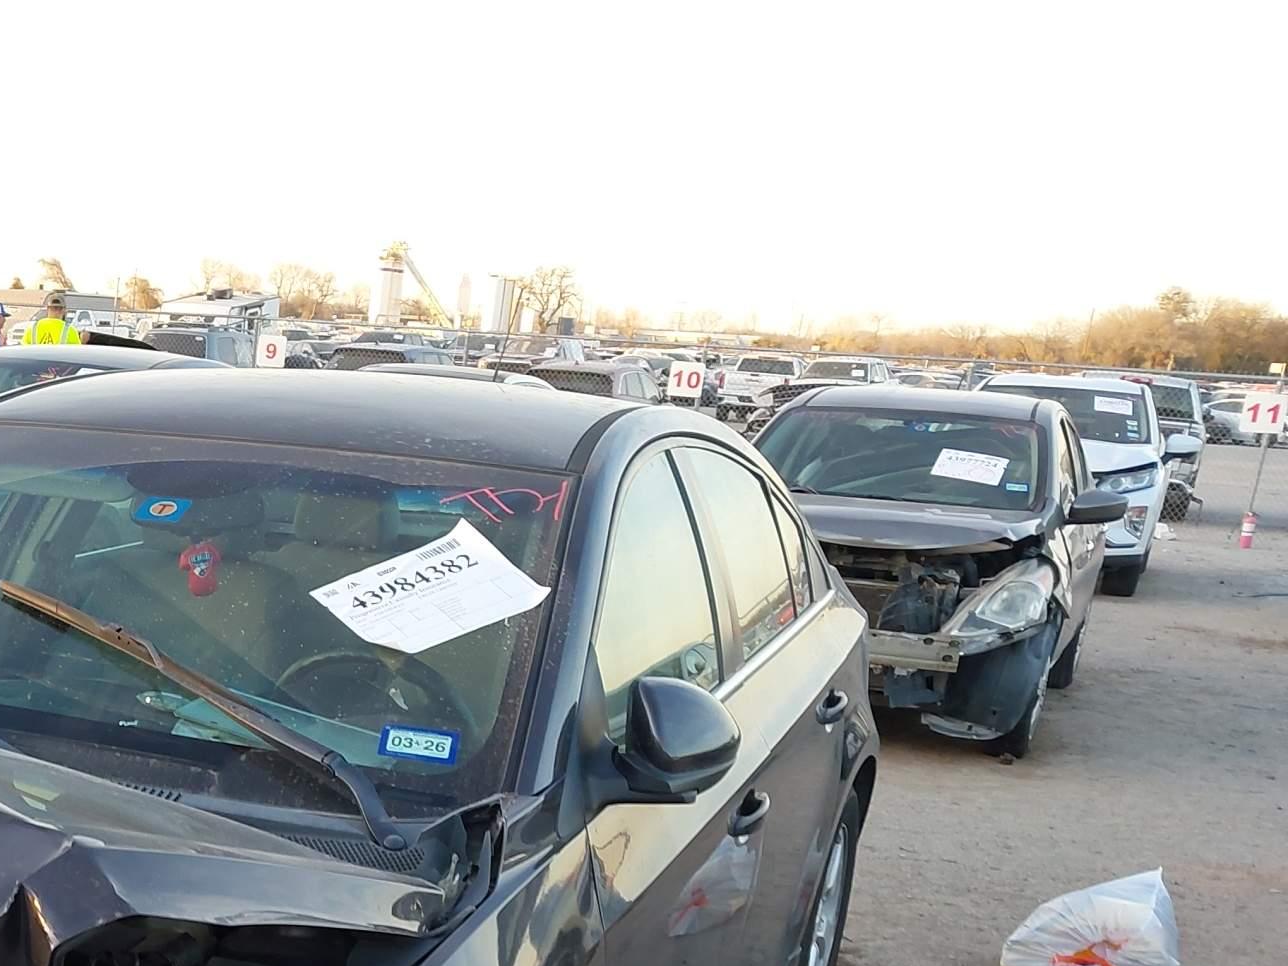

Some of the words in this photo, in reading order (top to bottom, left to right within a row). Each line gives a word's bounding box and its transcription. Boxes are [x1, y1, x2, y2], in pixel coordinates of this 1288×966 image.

[265, 343, 277, 360] 9
[672, 370, 701, 389] 10
[1247, 403, 1280, 424] 11
[352, 554, 479, 609] 43984382
[391, 735, 413, 749] 03
[423, 740, 447, 753] 26
